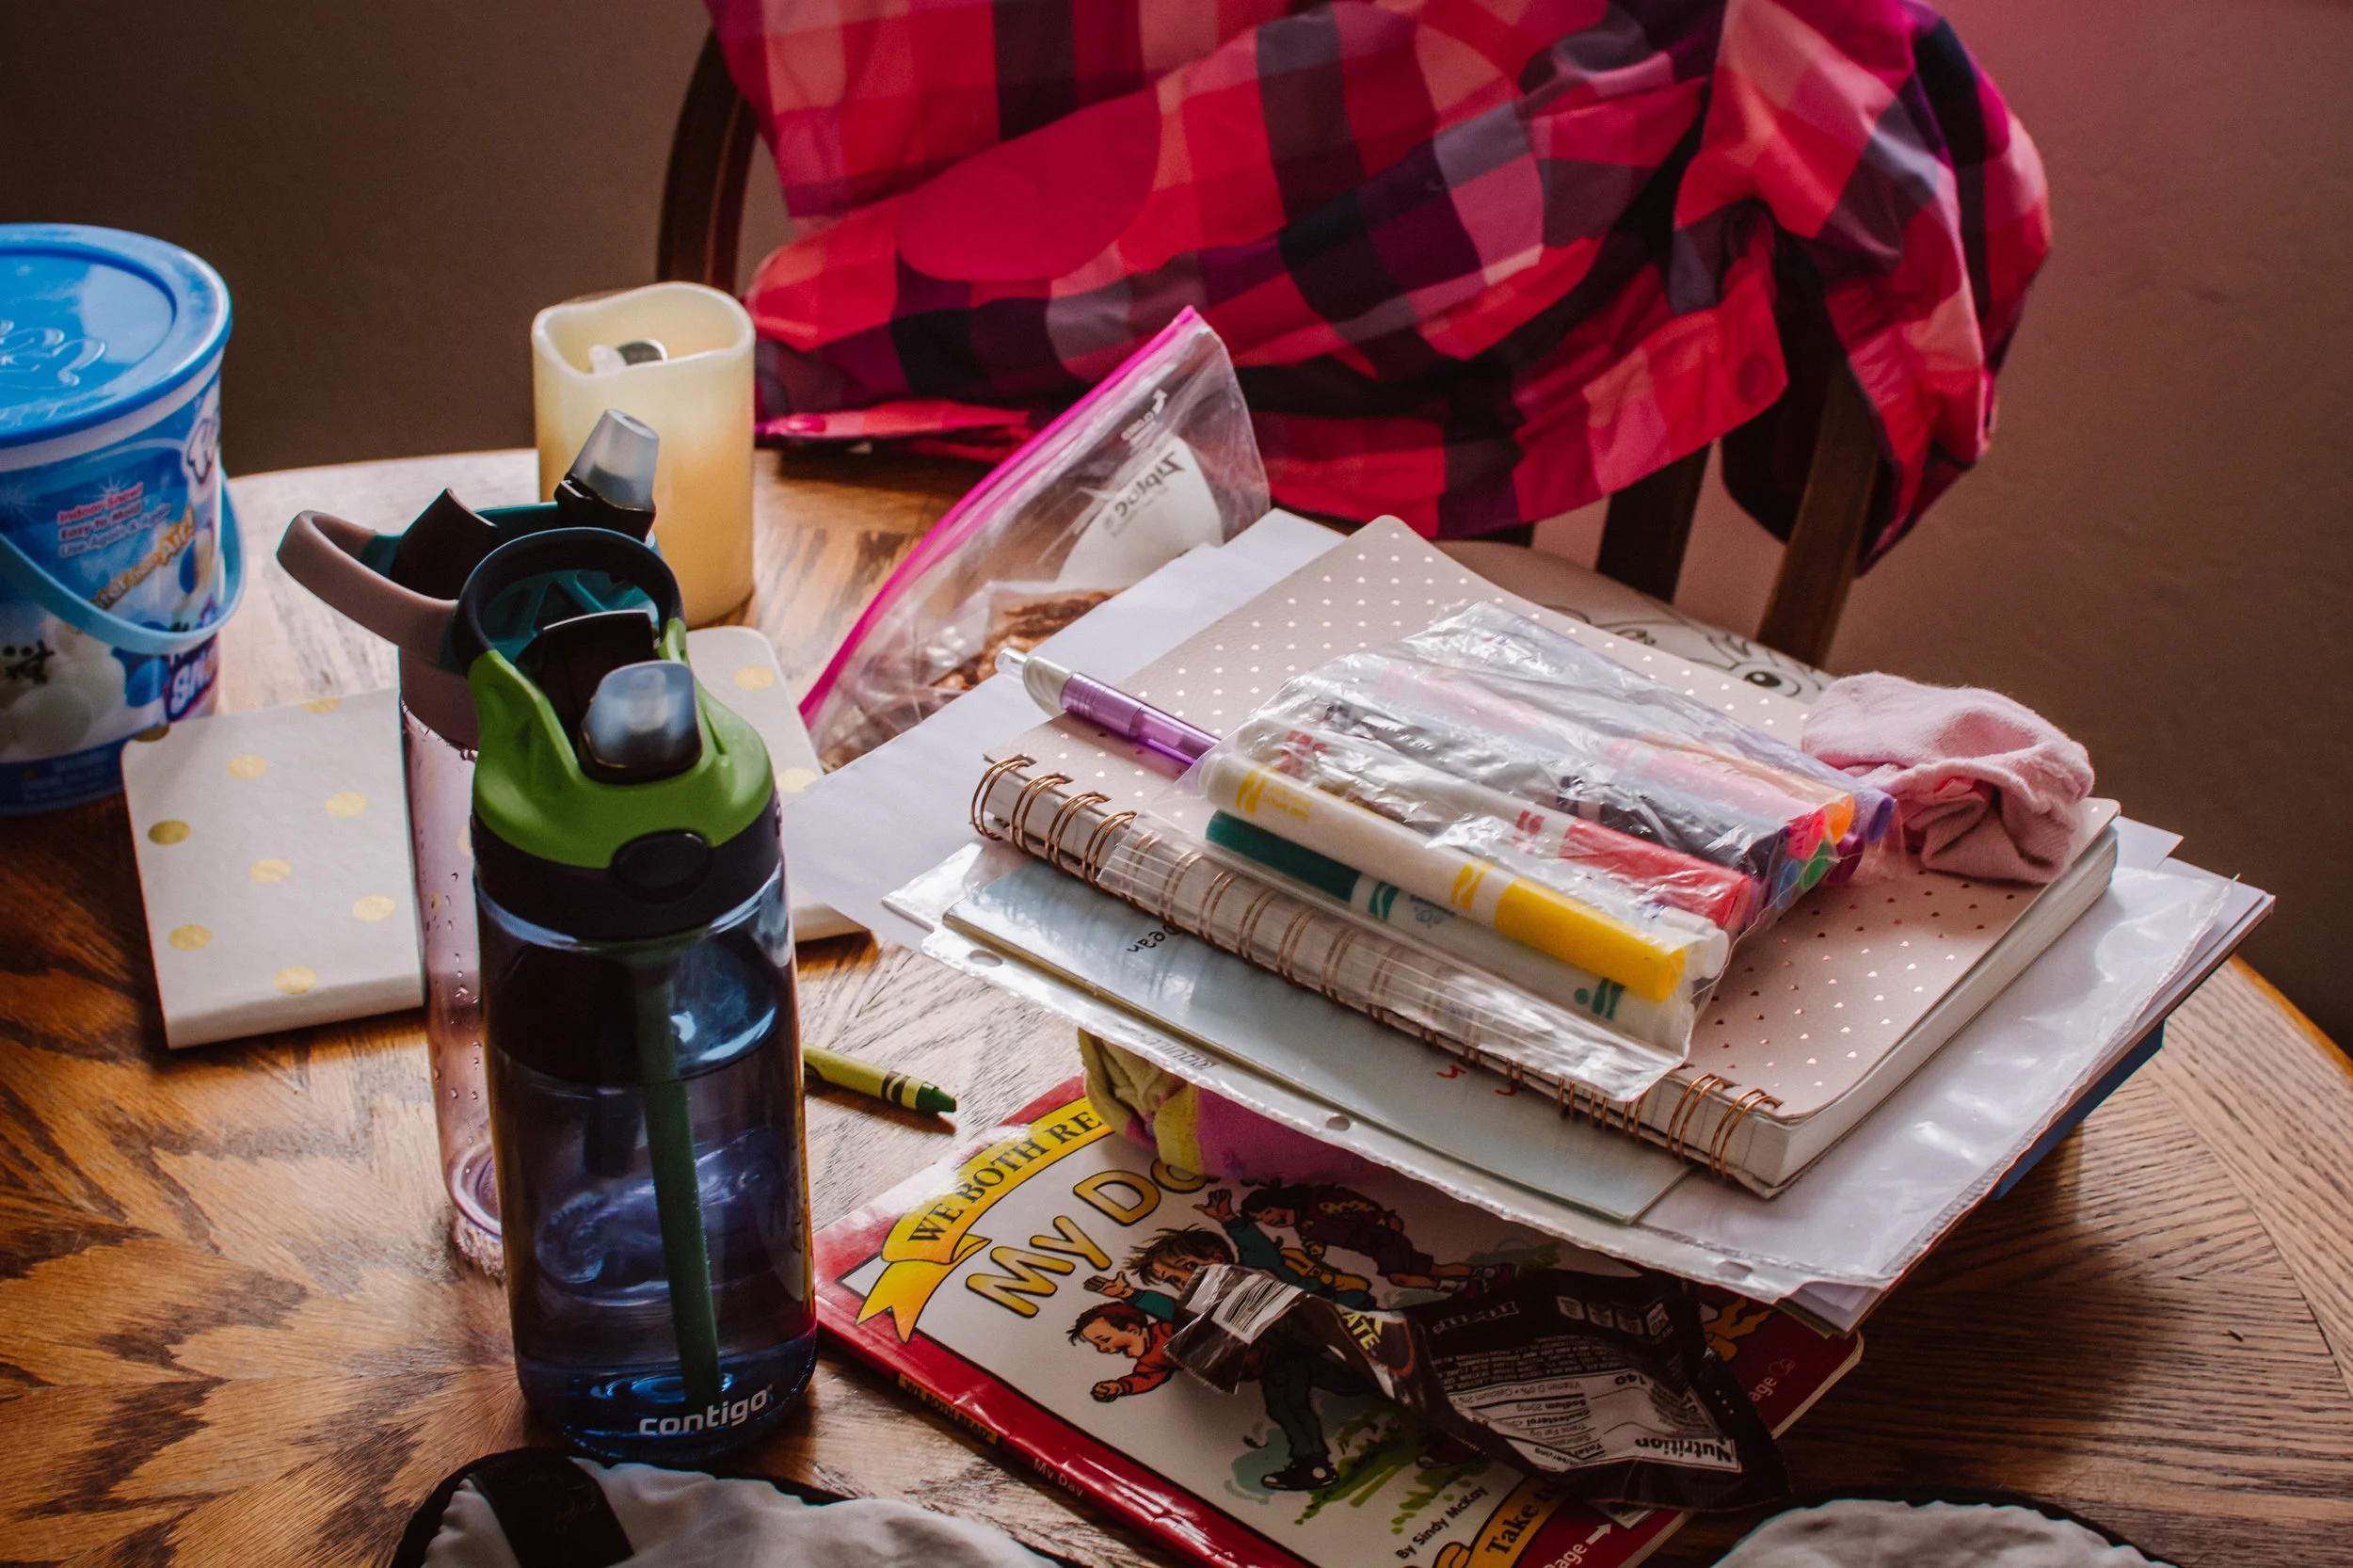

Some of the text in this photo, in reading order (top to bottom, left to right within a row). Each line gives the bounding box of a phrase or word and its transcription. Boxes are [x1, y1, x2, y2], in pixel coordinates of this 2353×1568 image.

[907, 1111, 1103, 1242] WE BOTH RE
[1614, 1372, 1646, 1385] 140
[639, 1387, 770, 1436] contigo
[1545, 1399, 1587, 1410] Sodium
[1635, 1436, 1732, 1464] Nutrition
[1033, 1458, 1084, 1496] My Day
[1396, 1485, 1490, 1560] By Sindy McKay
[1484, 1504, 1539, 1555] Take
[1542, 1543, 1588, 1568] age
